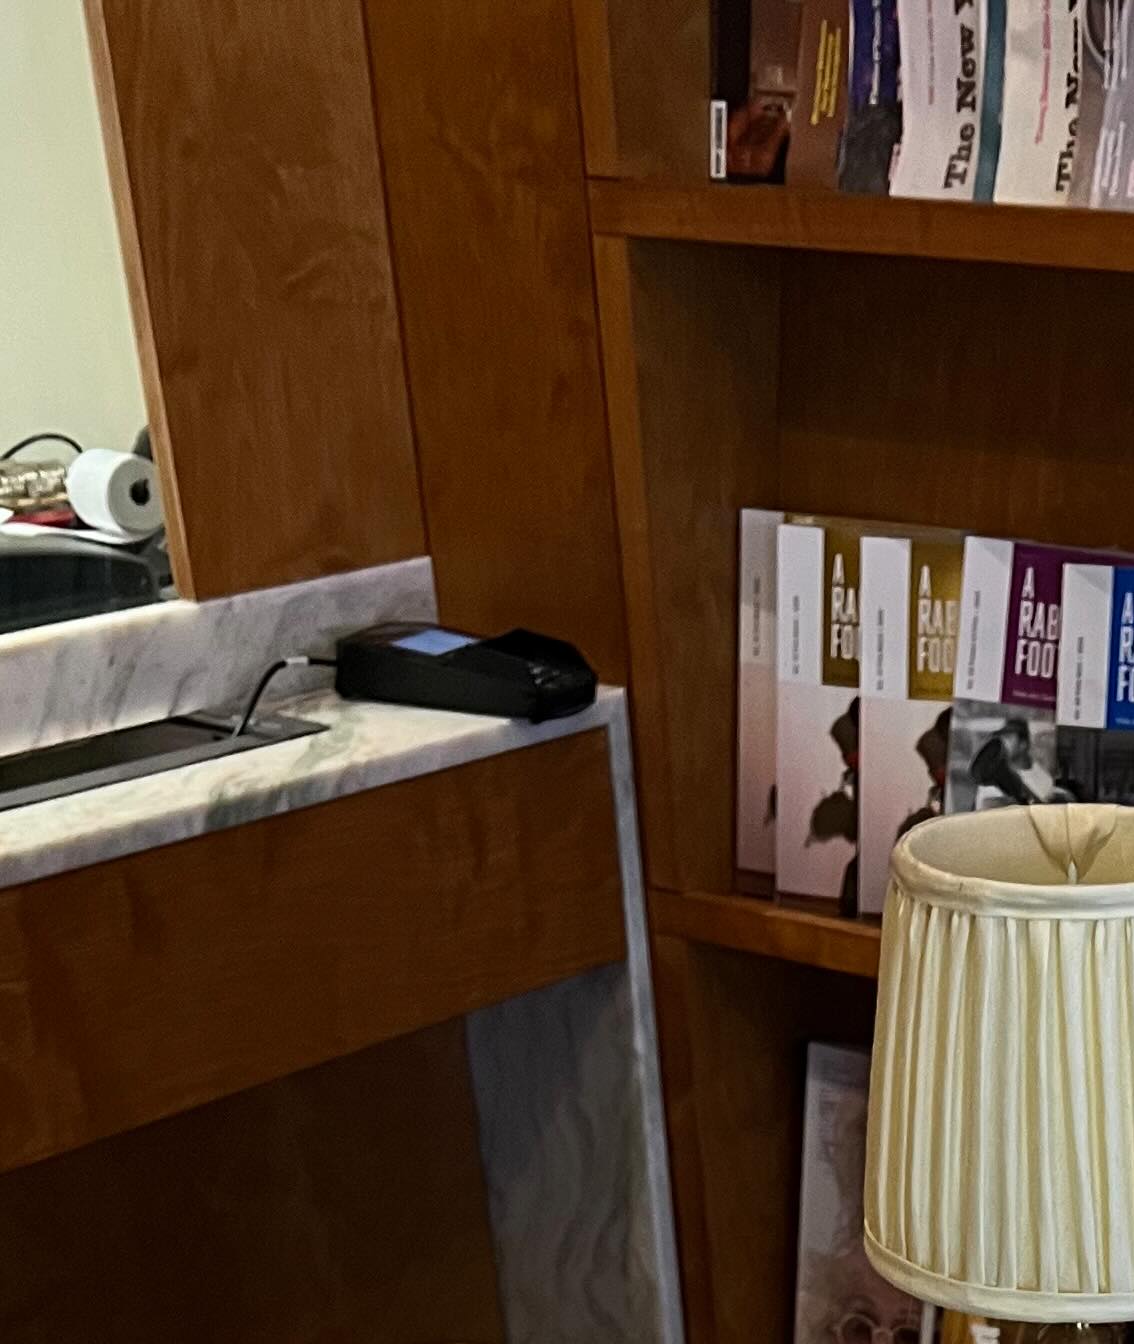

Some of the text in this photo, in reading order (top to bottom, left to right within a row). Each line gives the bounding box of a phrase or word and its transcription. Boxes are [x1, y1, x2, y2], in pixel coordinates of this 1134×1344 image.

[944, 23, 977, 189] The New
[832, 553, 844, 585] A
[917, 565, 932, 598] A
[1021, 567, 1035, 598] A
[1121, 592, 1134, 624] A
